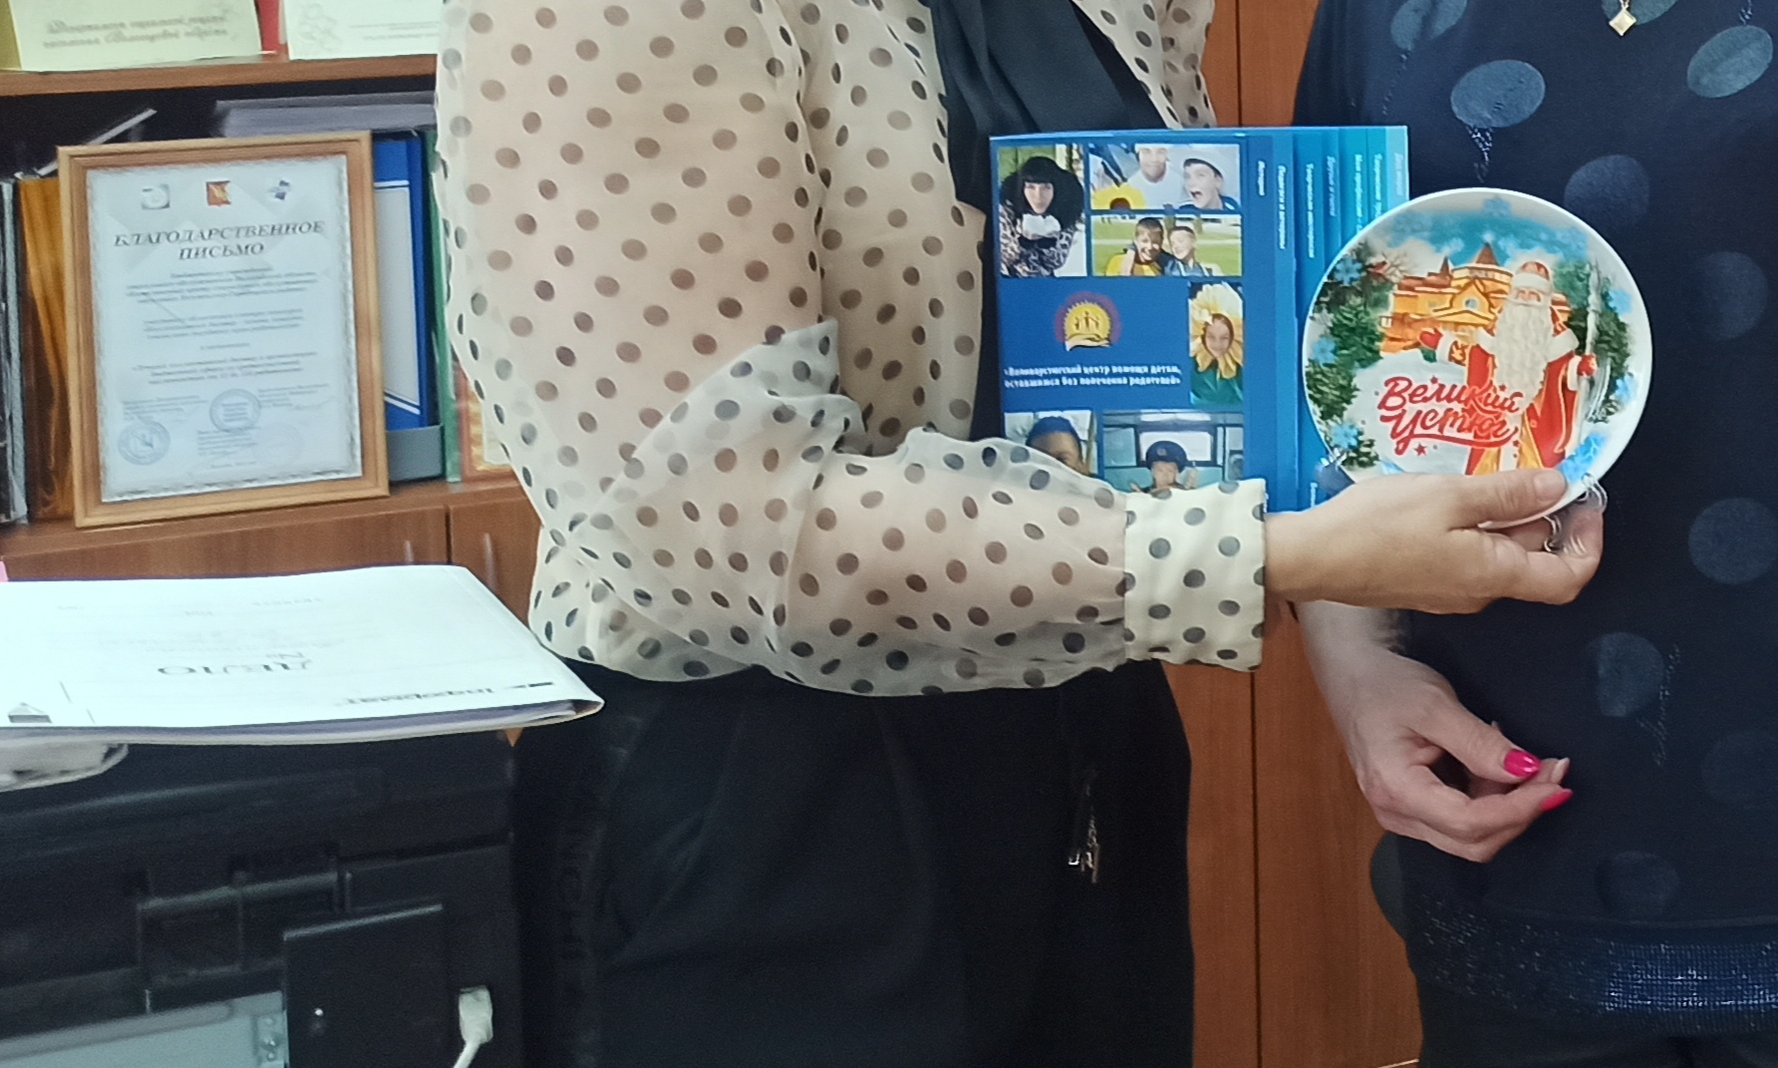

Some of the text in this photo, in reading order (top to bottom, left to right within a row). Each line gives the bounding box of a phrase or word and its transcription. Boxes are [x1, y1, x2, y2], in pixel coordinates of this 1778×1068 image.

[114, 220, 325, 247] БЛАГОДАРСТВЕННОЕ
[178, 243, 265, 261] ПИСЬМО
[1377, 375, 1524, 414] Великий
[1379, 407, 1519, 456] Устюг
[157, 658, 313, 676] ДЕЛО
